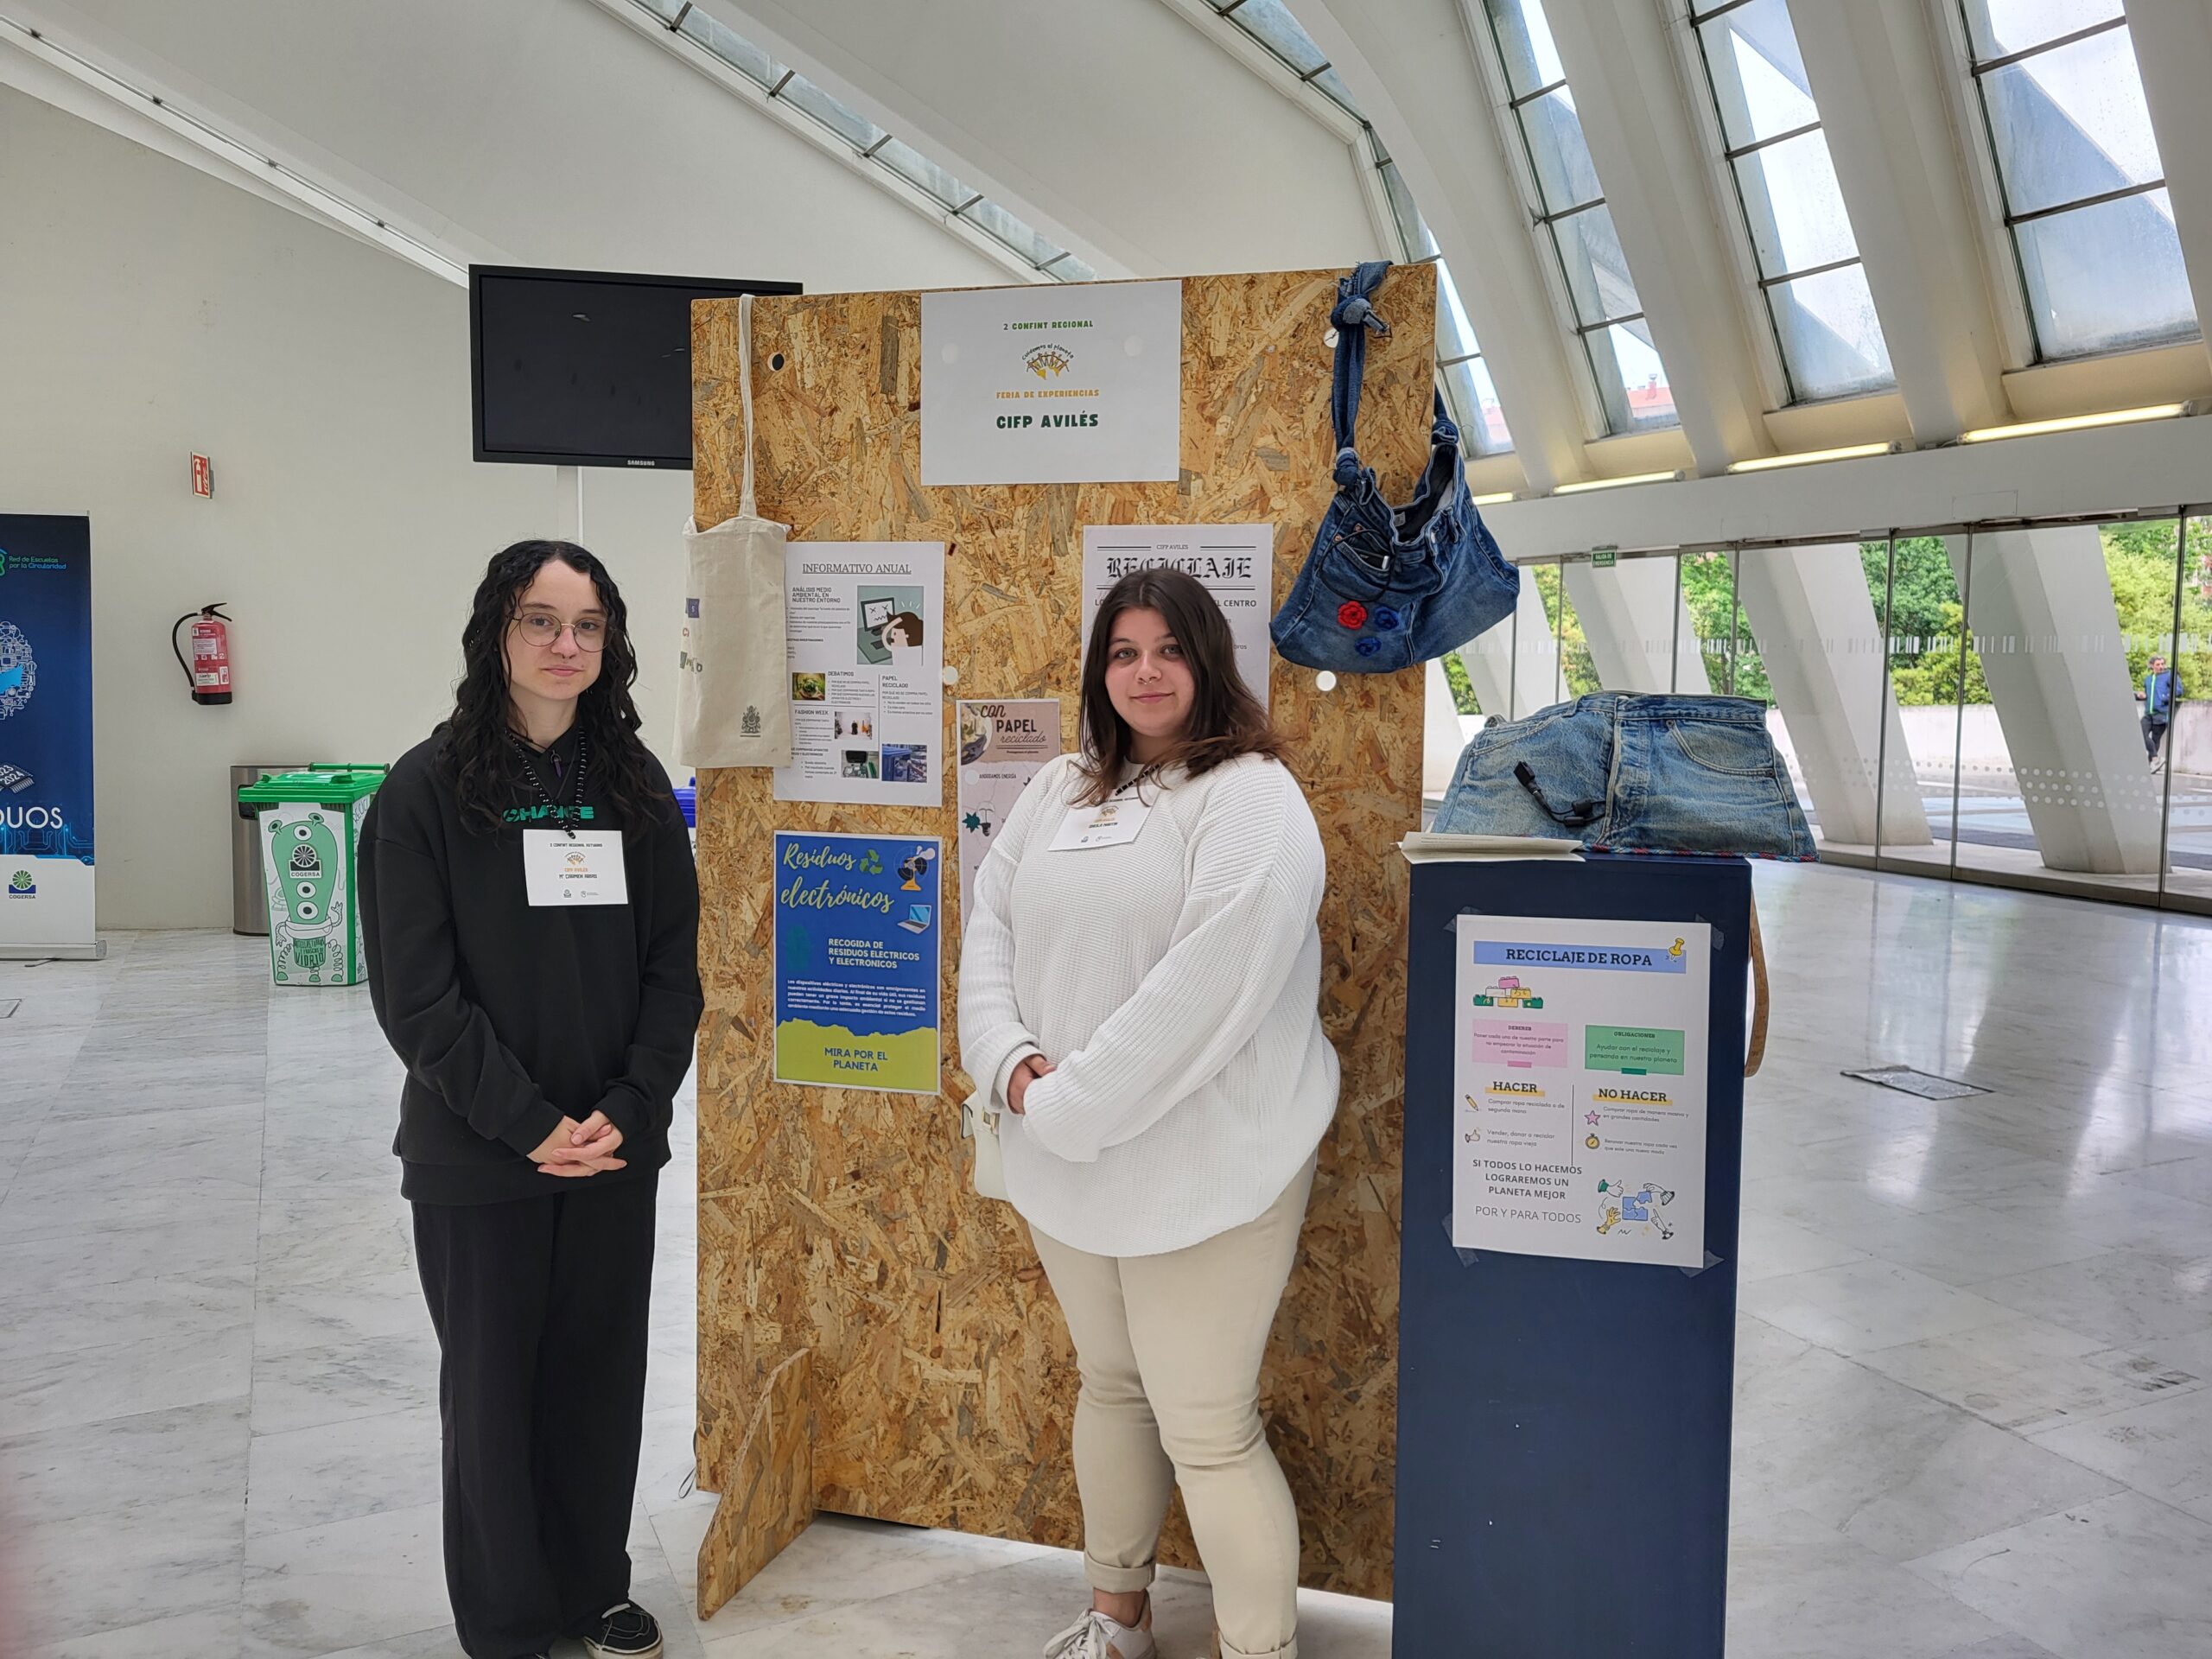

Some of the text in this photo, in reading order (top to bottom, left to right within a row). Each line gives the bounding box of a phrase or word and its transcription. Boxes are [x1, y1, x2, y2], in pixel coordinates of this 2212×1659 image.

[997, 410, 1098, 429] CIFP AVILÉS
[803, 563, 912, 574] INFORMATIVO ANUAL
[981, 705, 1006, 717] con
[996, 719, 1037, 733] PAPEL
[1001, 730, 1046, 743] reciclado
[0, 771, 24, 785] 2024
[784, 842, 856, 870] Residuos
[781, 876, 894, 913] electrónicos
[829, 938, 870, 948] RECOGIDA
[296, 952, 323, 966] VIDRIO
[870, 950, 919, 961] ELECTRICOS
[1506, 949, 1652, 966] RECICLAJE DE ROPA
[836, 958, 897, 969] ELECTRONICOS
[824, 1047, 887, 1060] MIRA POR EL
[834, 1060, 878, 1071] PLANETA
[1493, 1082, 1537, 1092] HACER
[1599, 1089, 1667, 1102] NO HACER
[1484, 1160, 1516, 1169] TODOS
[1535, 1165, 1582, 1174] HACEMOS
[1485, 1173, 1569, 1186] LOGRAREMOS UN
[1489, 1186, 1566, 1199] PLANETA MEJOR
[1476, 1206, 1497, 1217] POR
[1510, 1210, 1539, 1220] PARA
[1541, 1211, 1581, 1223] TODOS
